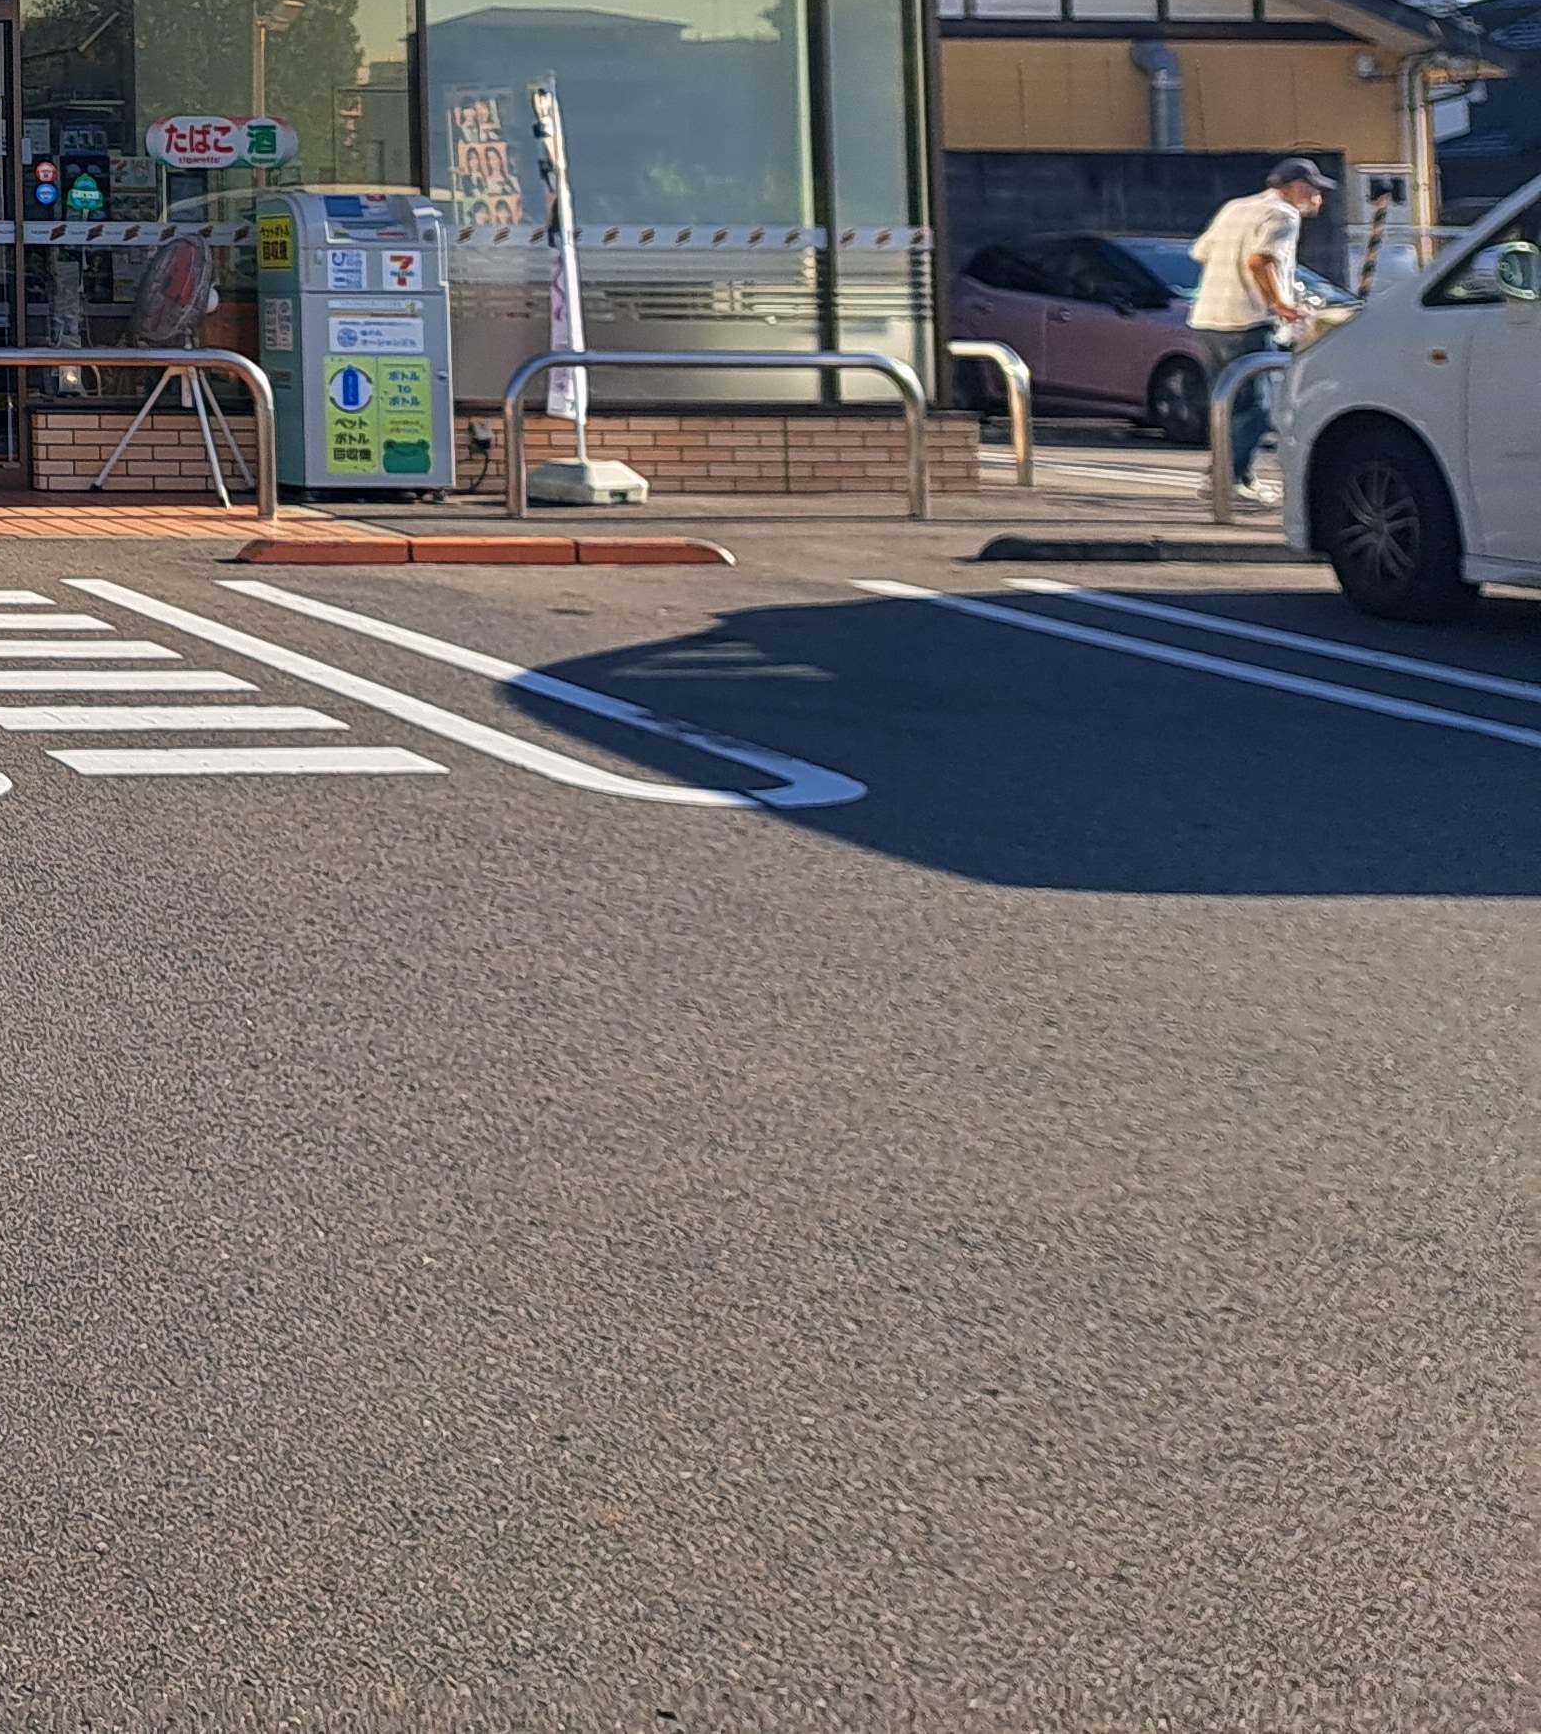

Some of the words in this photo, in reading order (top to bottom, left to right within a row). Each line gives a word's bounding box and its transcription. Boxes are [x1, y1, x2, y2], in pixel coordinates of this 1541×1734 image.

[164, 123, 234, 154] たばこ
[246, 124, 277, 154] 酒
